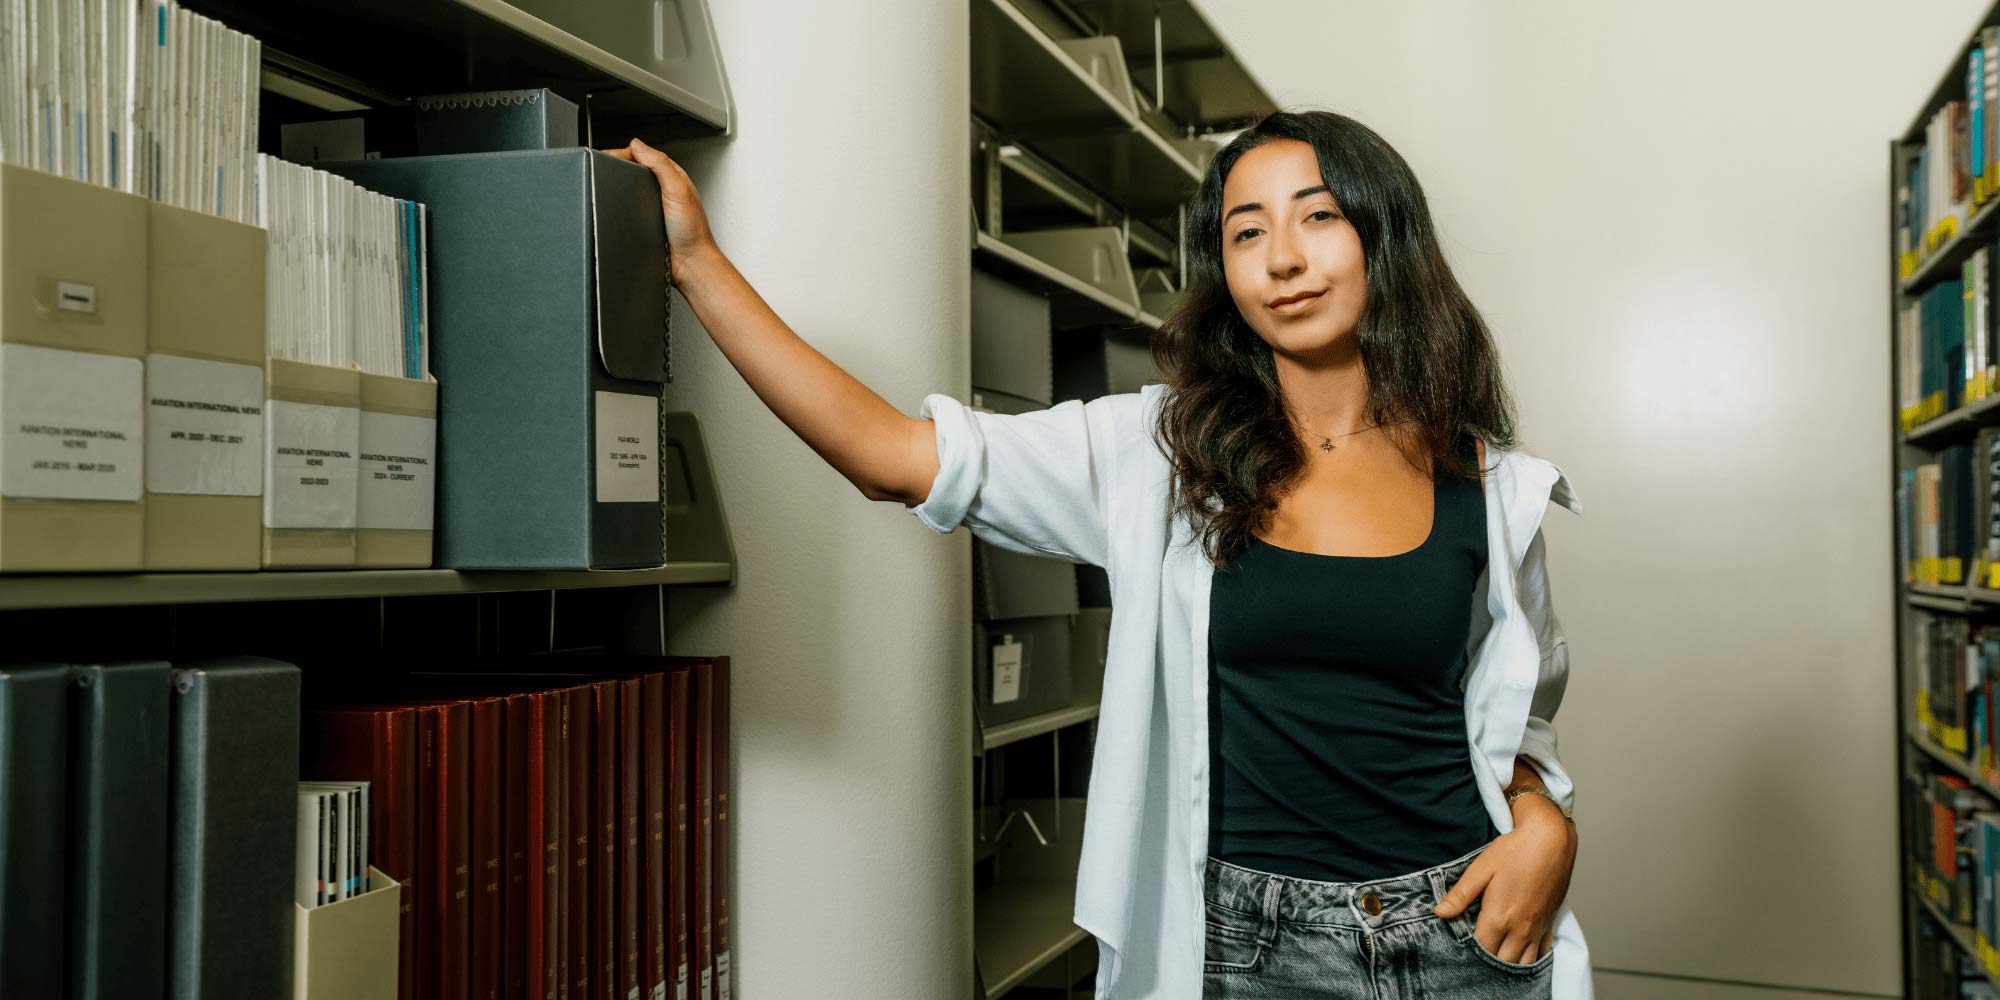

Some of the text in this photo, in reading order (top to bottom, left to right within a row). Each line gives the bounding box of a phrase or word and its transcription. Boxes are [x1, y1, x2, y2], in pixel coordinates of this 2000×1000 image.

[151, 398, 261, 415] AVIATION INTERNATIONAL NEWS
[21, 425, 127, 440] AVIATION INTERNATIONAL
[63, 440, 87, 449] NEWS
[277, 447, 352, 459] AVIATION INTERNATIONAL
[306, 458, 323, 466] NEWS
[360, 453, 428, 465] AVIATION INTERNATIONAL
[387, 464, 403, 472] NEWS
[390, 473, 416, 481] CURRENT
